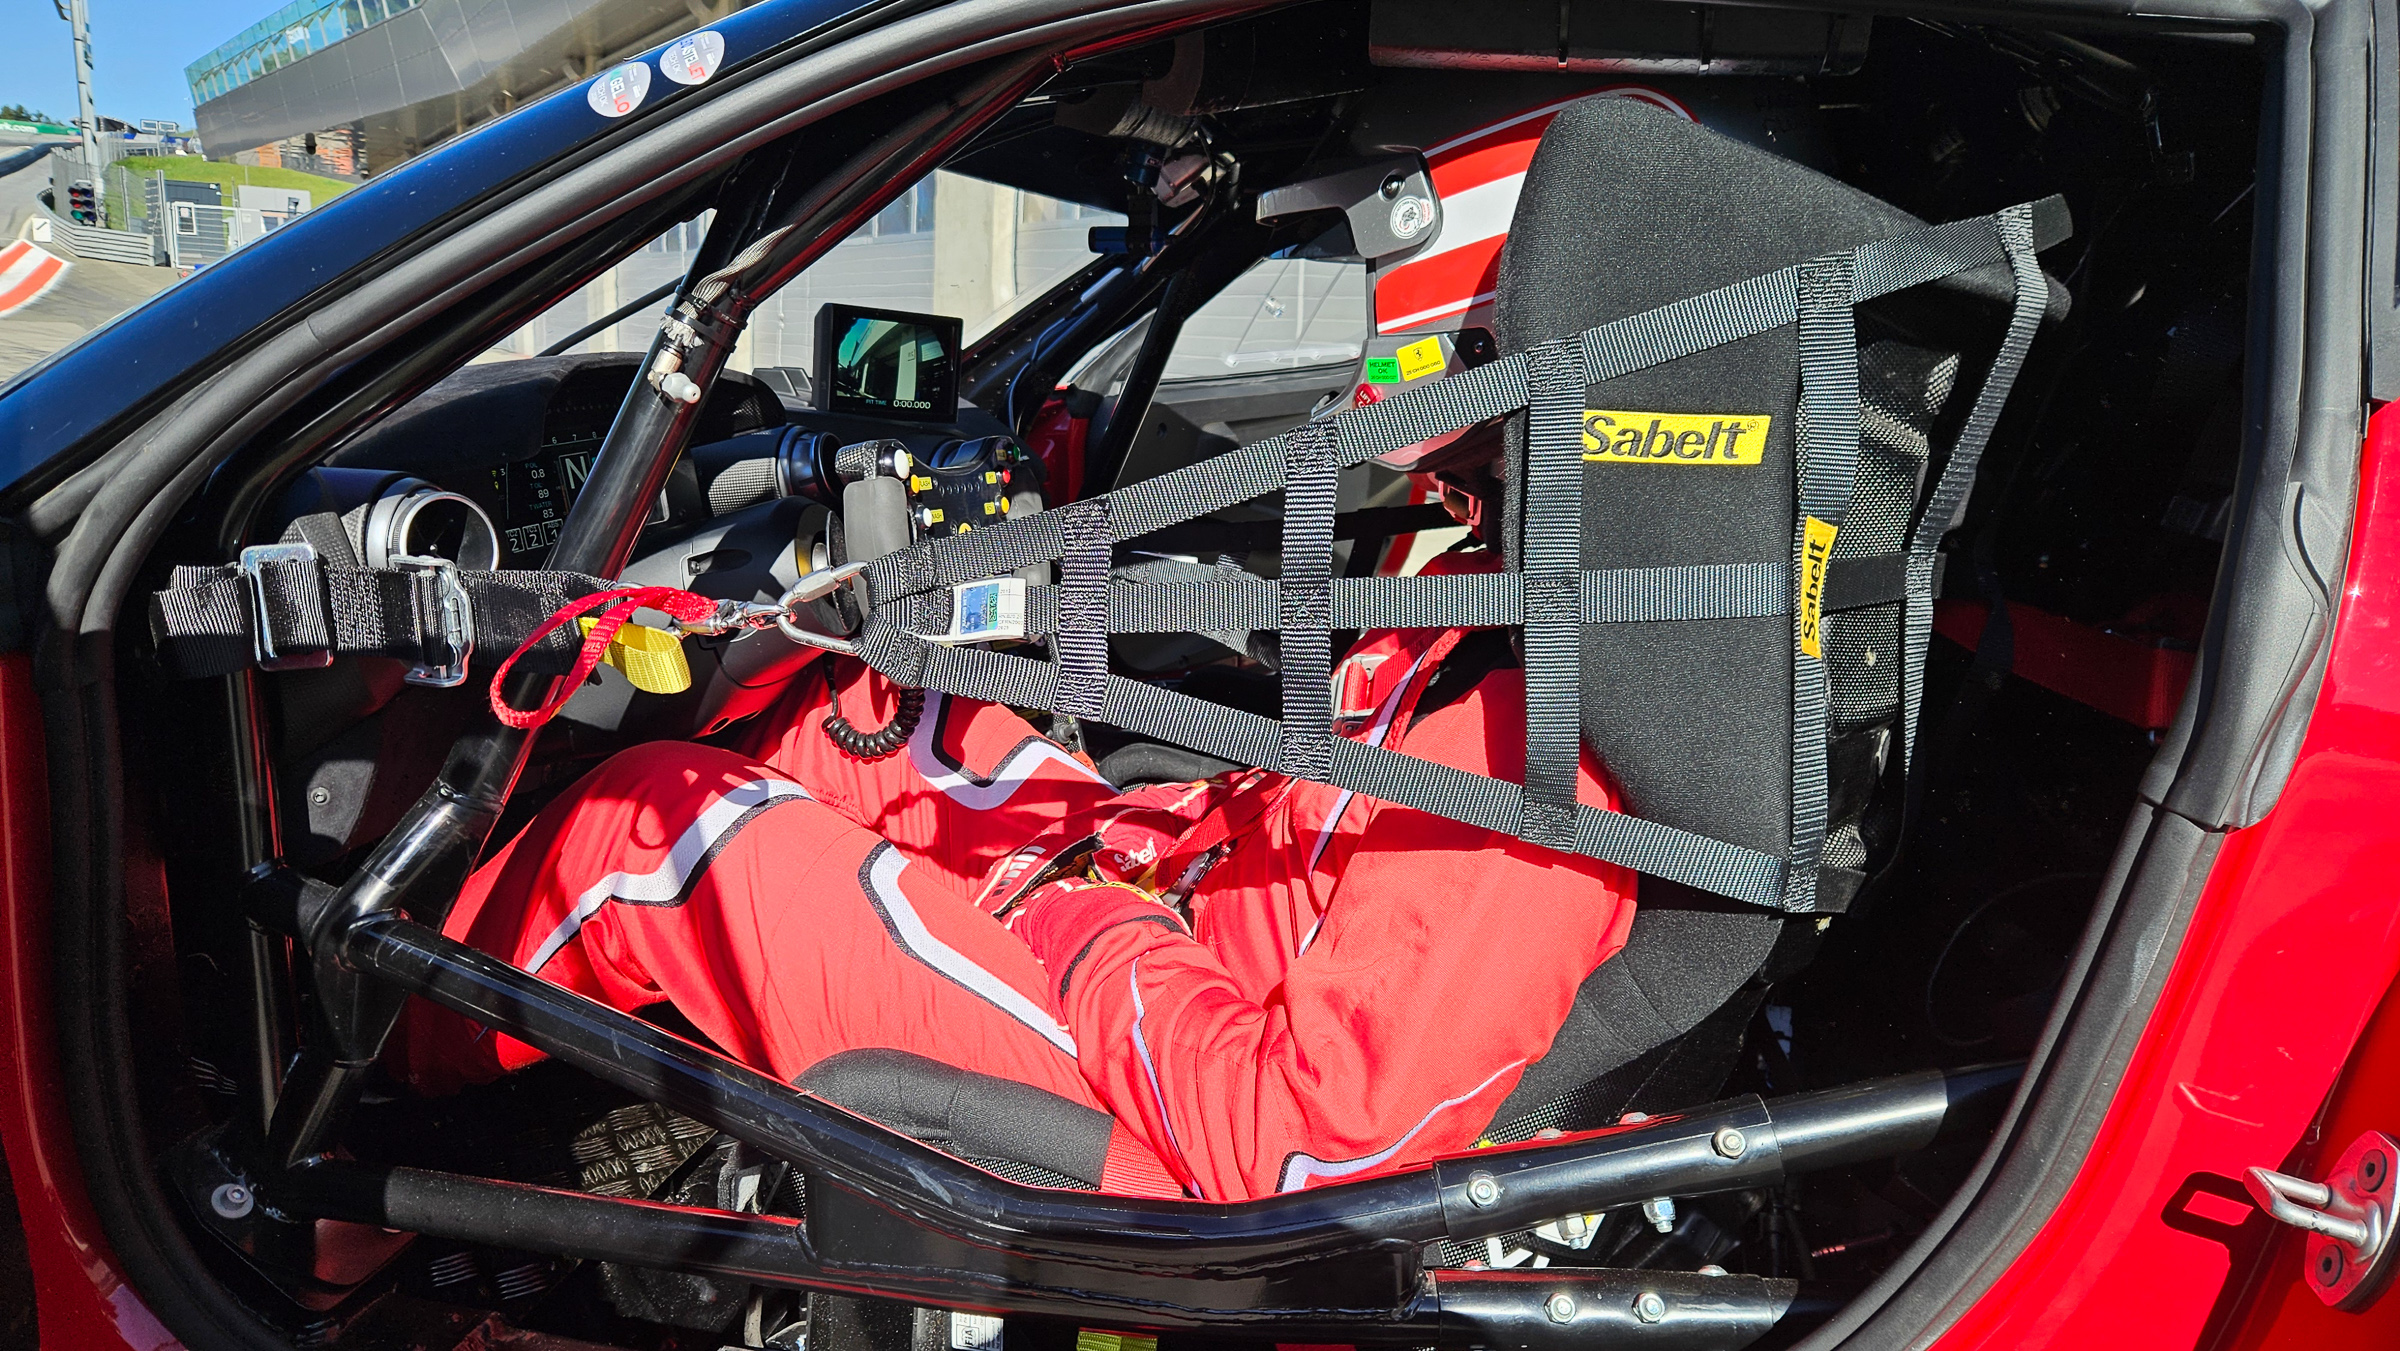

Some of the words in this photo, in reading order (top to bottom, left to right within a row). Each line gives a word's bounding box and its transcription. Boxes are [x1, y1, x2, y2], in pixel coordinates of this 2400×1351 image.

[1359, 390, 1371, 404] LIFT
[893, 400, 931, 409] 0:00.000
[551, 436, 558, 444] 6
[1584, 414, 1747, 459] Sabelt
[531, 468, 546, 479] 0.8
[565, 455, 588, 489] N
[537, 488, 550, 499] 89
[542, 508, 554, 519] 83
[510, 538, 519, 552] 2
[529, 534, 539, 547] 2
[1804, 539, 1827, 642] Sabelt
[1114, 836, 1158, 872] Sabelt
